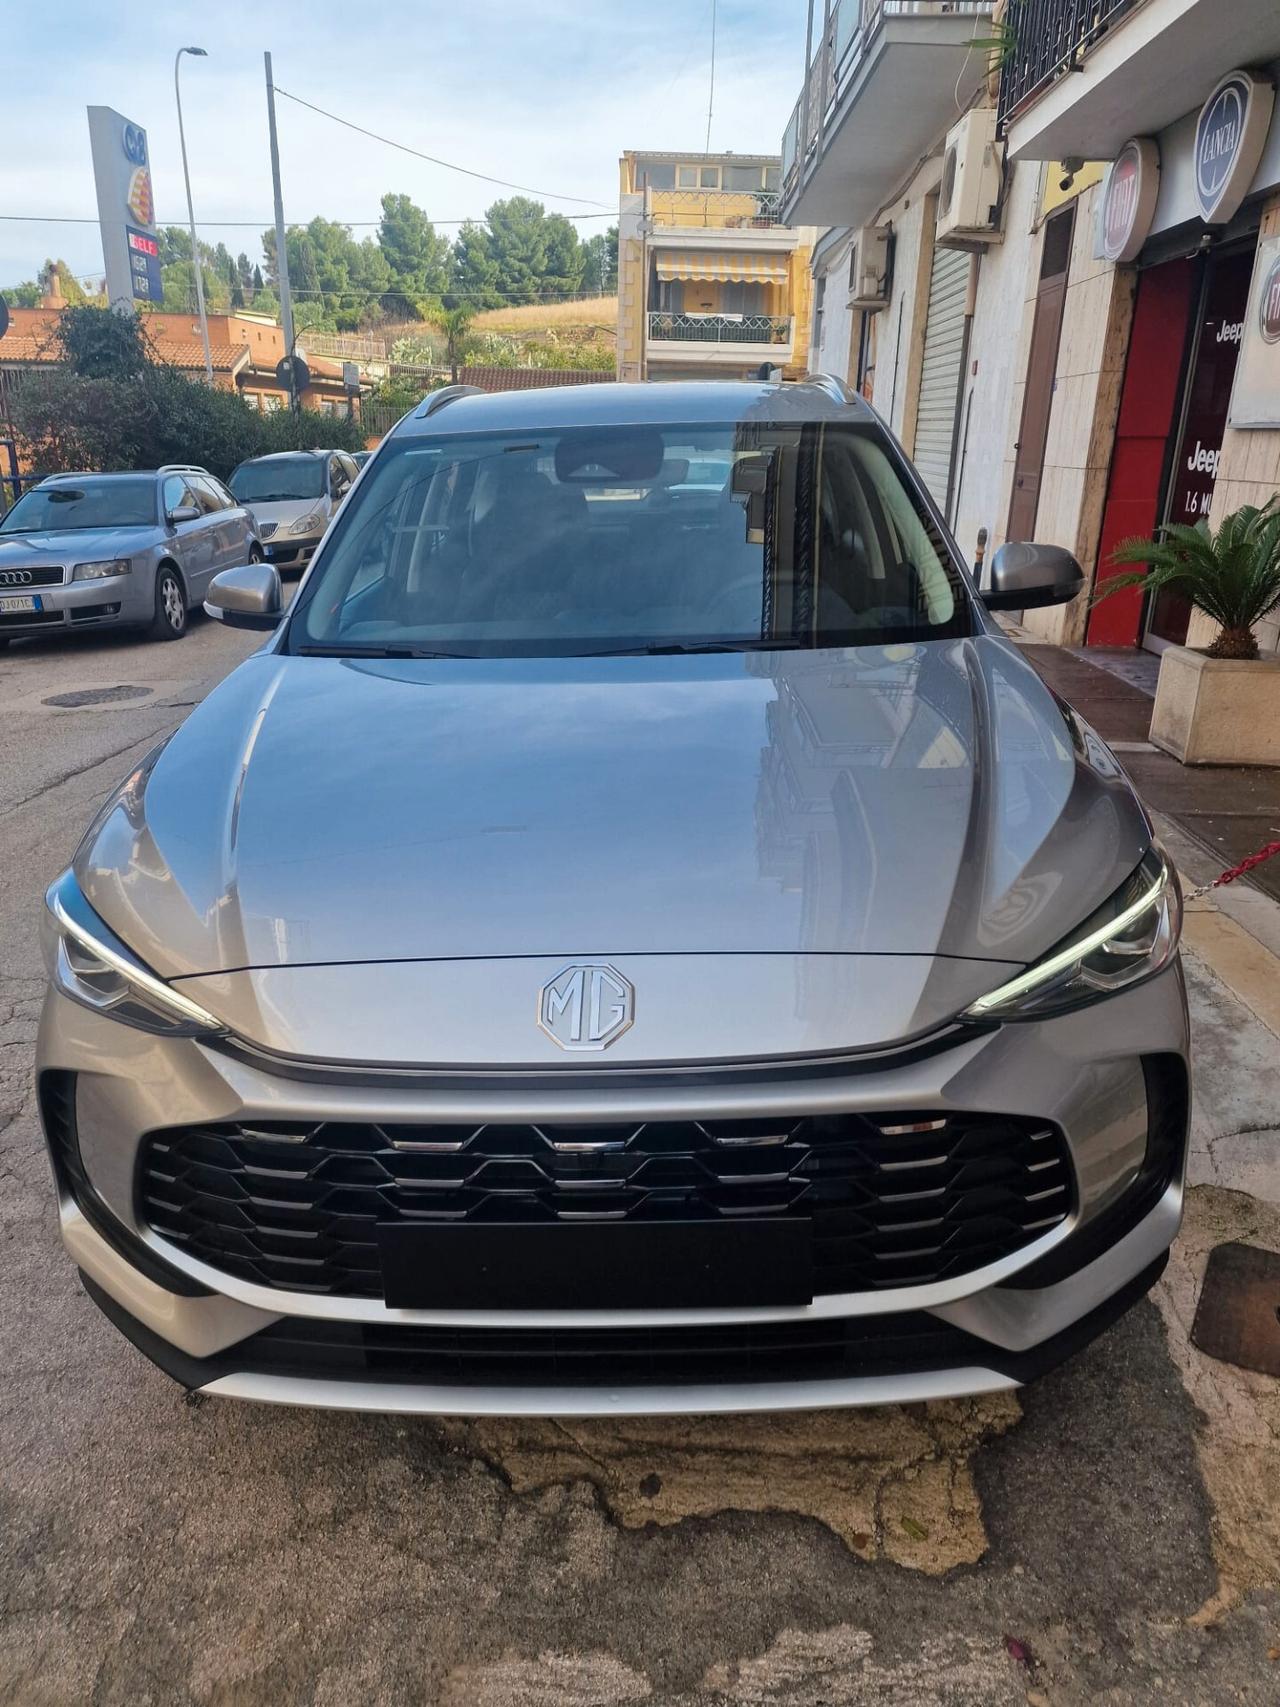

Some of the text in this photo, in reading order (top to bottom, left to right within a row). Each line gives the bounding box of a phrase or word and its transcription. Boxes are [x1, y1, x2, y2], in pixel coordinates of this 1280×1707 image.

[1203, 120, 1235, 164] LANCIA
[1216, 320, 1244, 345] Jeep
[1185, 490, 1198, 513] 1.6
[547, 970, 625, 1041] MG
